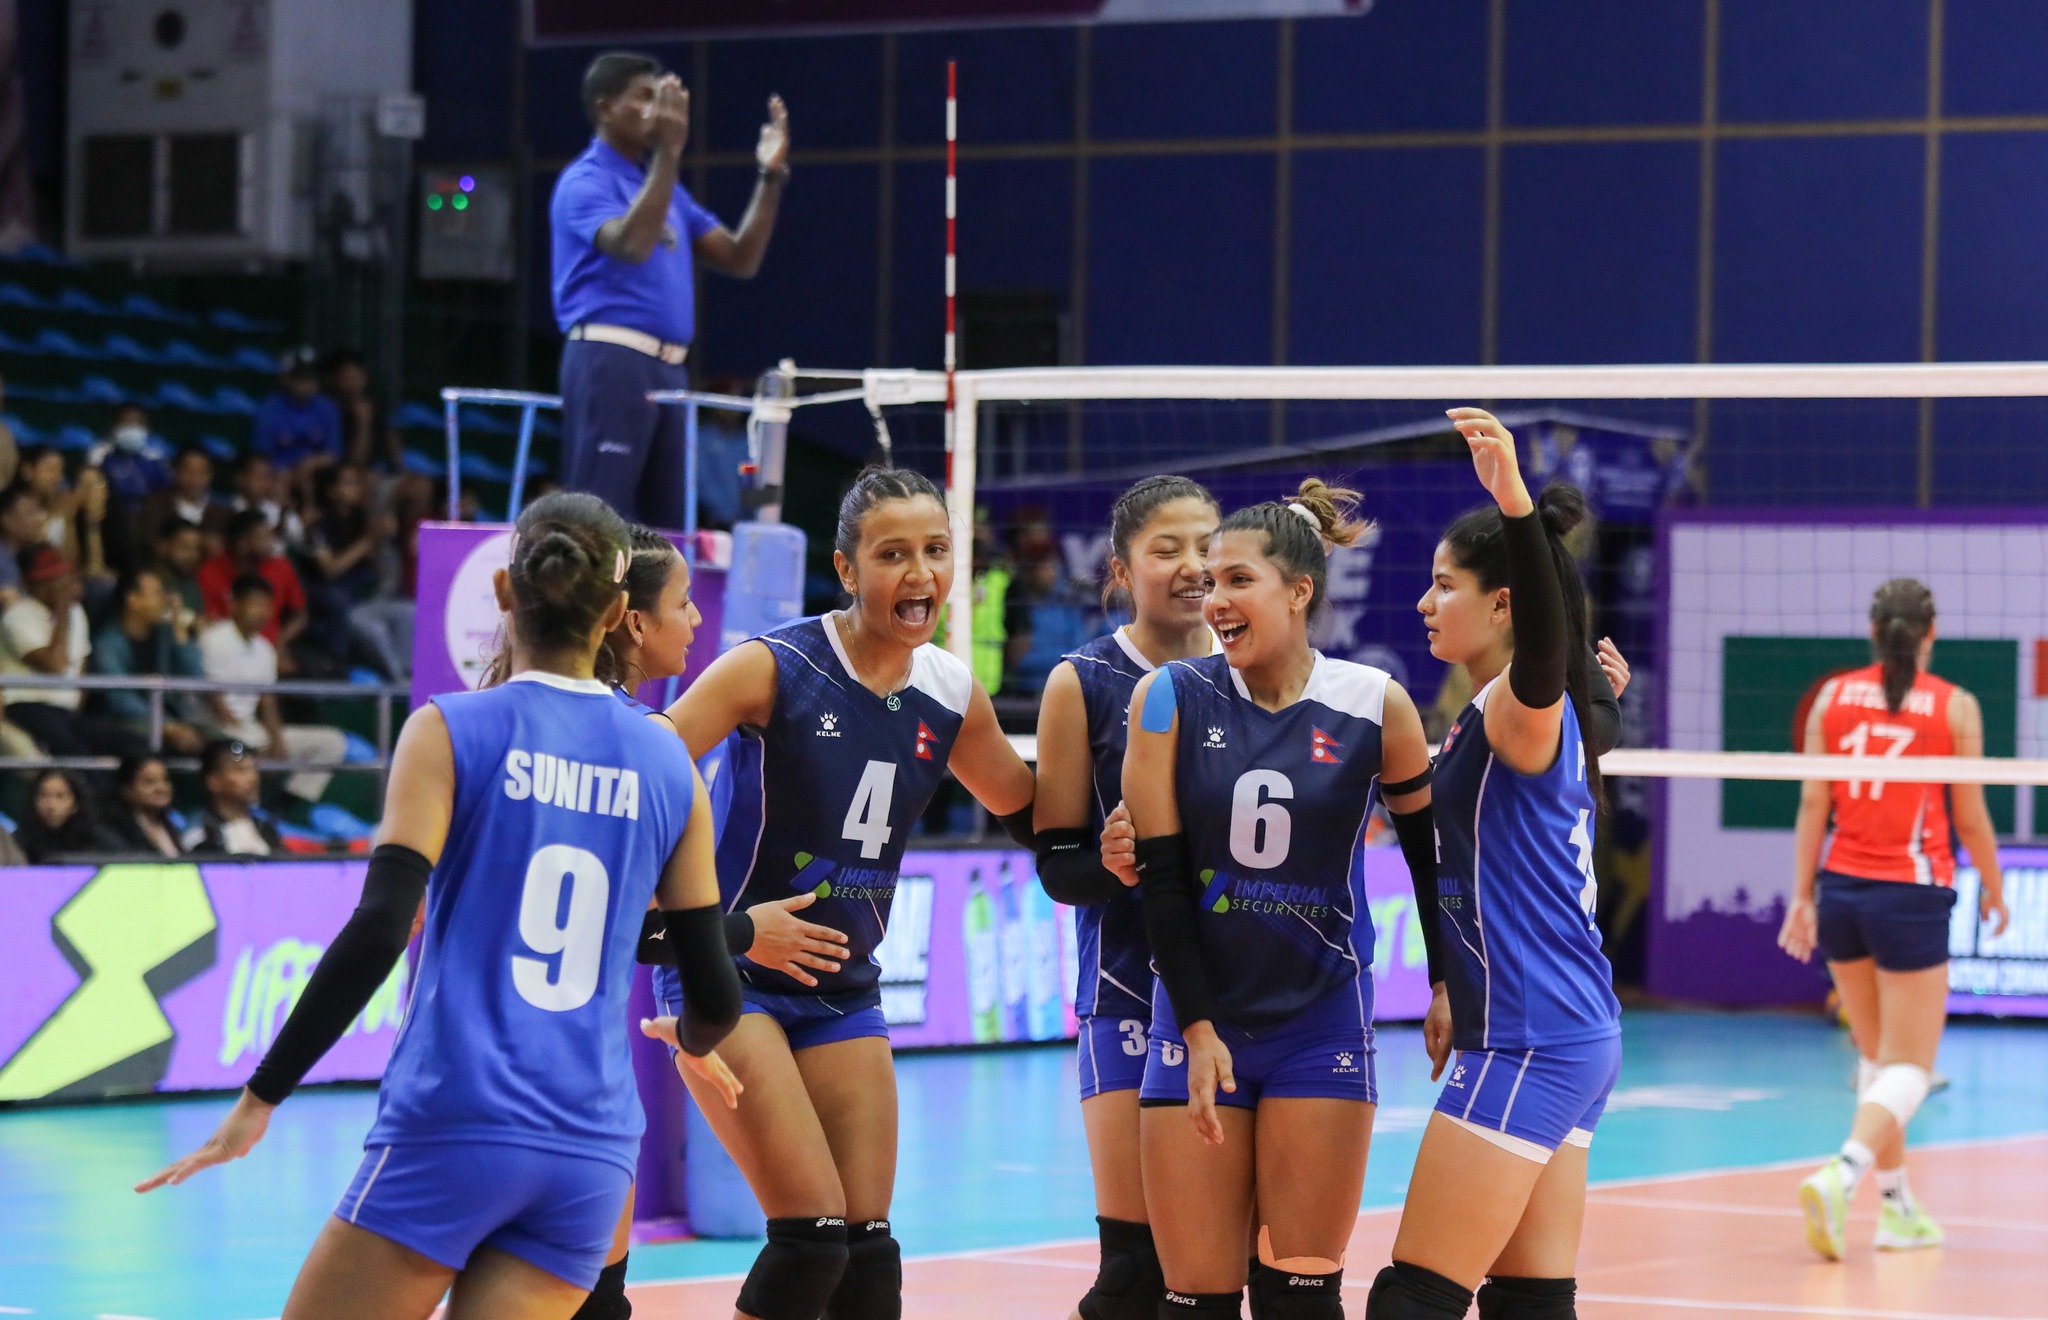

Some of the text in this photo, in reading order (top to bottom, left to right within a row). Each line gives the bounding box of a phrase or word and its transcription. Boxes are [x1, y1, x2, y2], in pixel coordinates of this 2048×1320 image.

[503, 749, 640, 821] SUNITA
[1839, 721, 1916, 800] 17
[841, 759, 897, 860] 4
[1229, 768, 1294, 870] 6
[837, 867, 898, 887] IMPERIA
[1231, 898, 1328, 919] SECURITIES
[1234, 879, 1330, 905] IMPERIAL
[511, 843, 610, 1012] 9
[1119, 1019, 1147, 1056] 3
